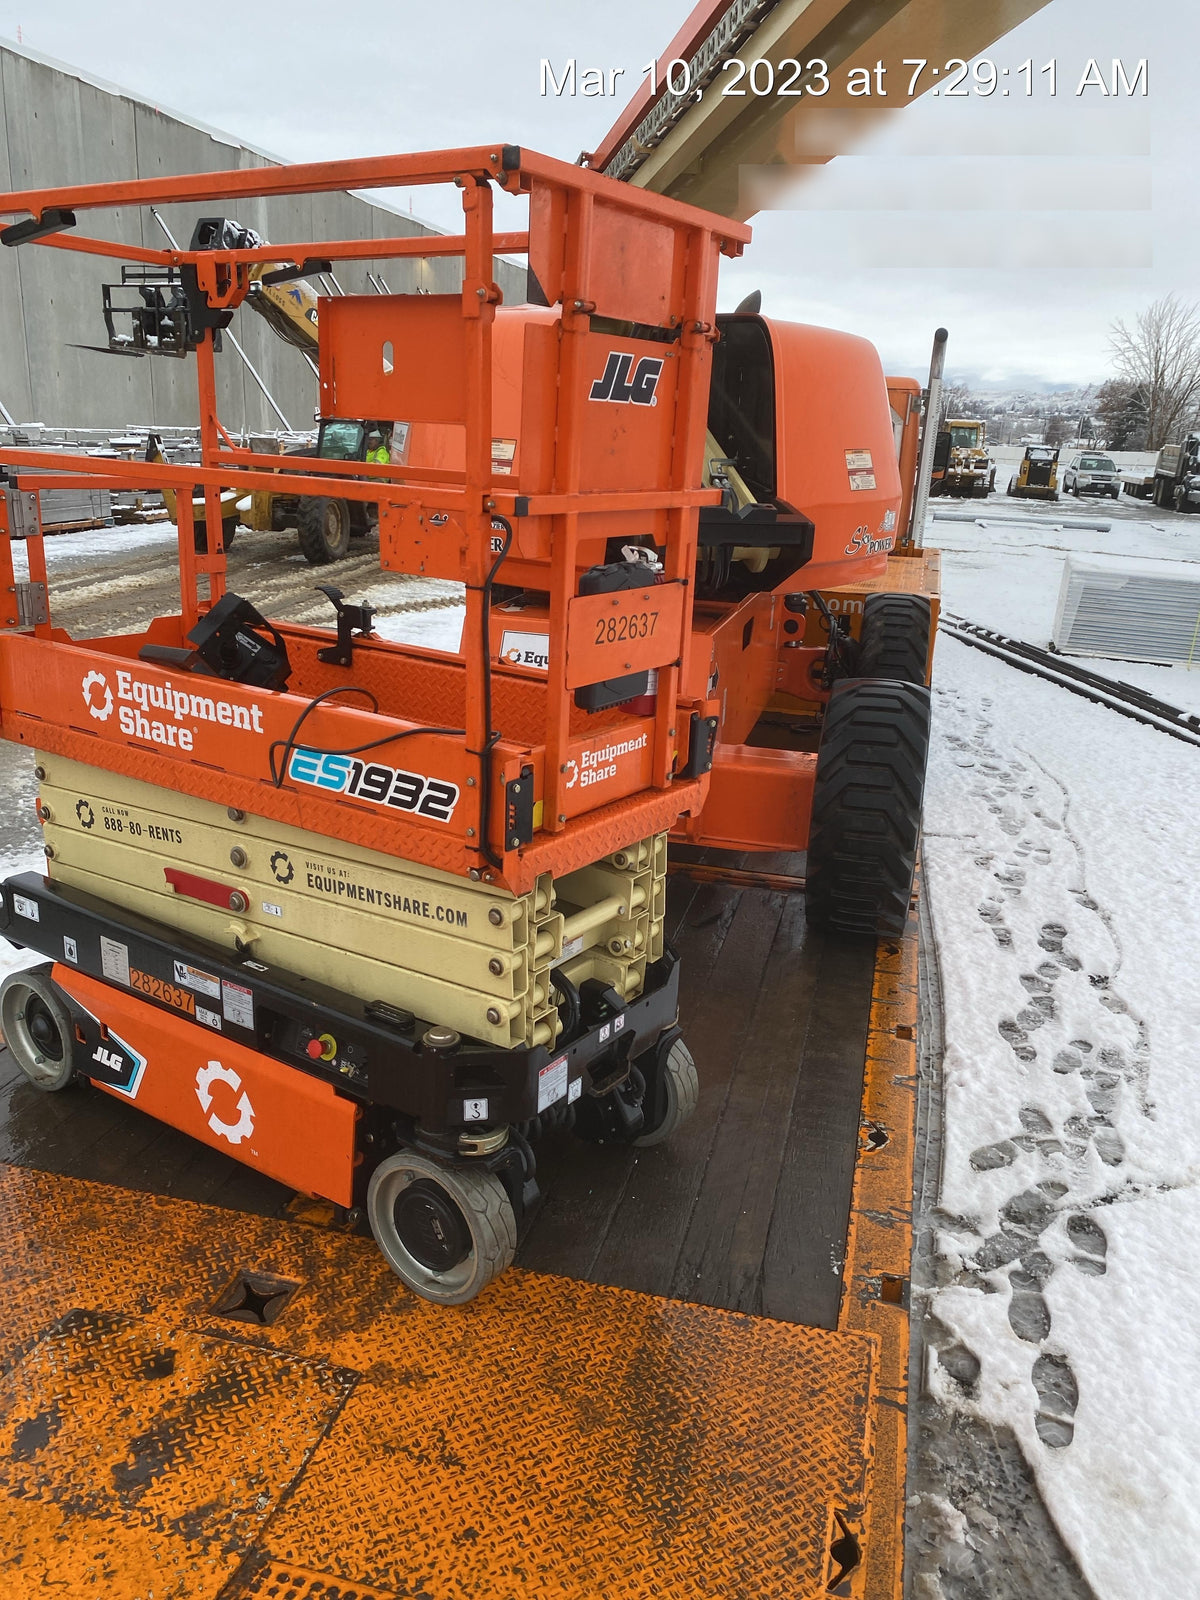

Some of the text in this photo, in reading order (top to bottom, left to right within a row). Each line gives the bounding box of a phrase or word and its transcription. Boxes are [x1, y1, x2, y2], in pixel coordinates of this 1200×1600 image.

[588, 351, 664, 406] JLG
[594, 612, 660, 646] 282637
[115, 670, 264, 734] Equipment
[118, 705, 194, 752] Share
[580, 733, 648, 769] Equipment
[289, 748, 459, 822] ES1932
[580, 764, 617, 788] Share
[101, 805, 129, 817] CALL NOW
[103, 816, 183, 844] 888-80-RENTS
[305, 861, 350, 879] VISIT US AT:
[306, 873, 468, 928] EQUIPMENTSHARE.COM
[131, 969, 193, 1012] 282637
[91, 1046, 123, 1072] JLG
